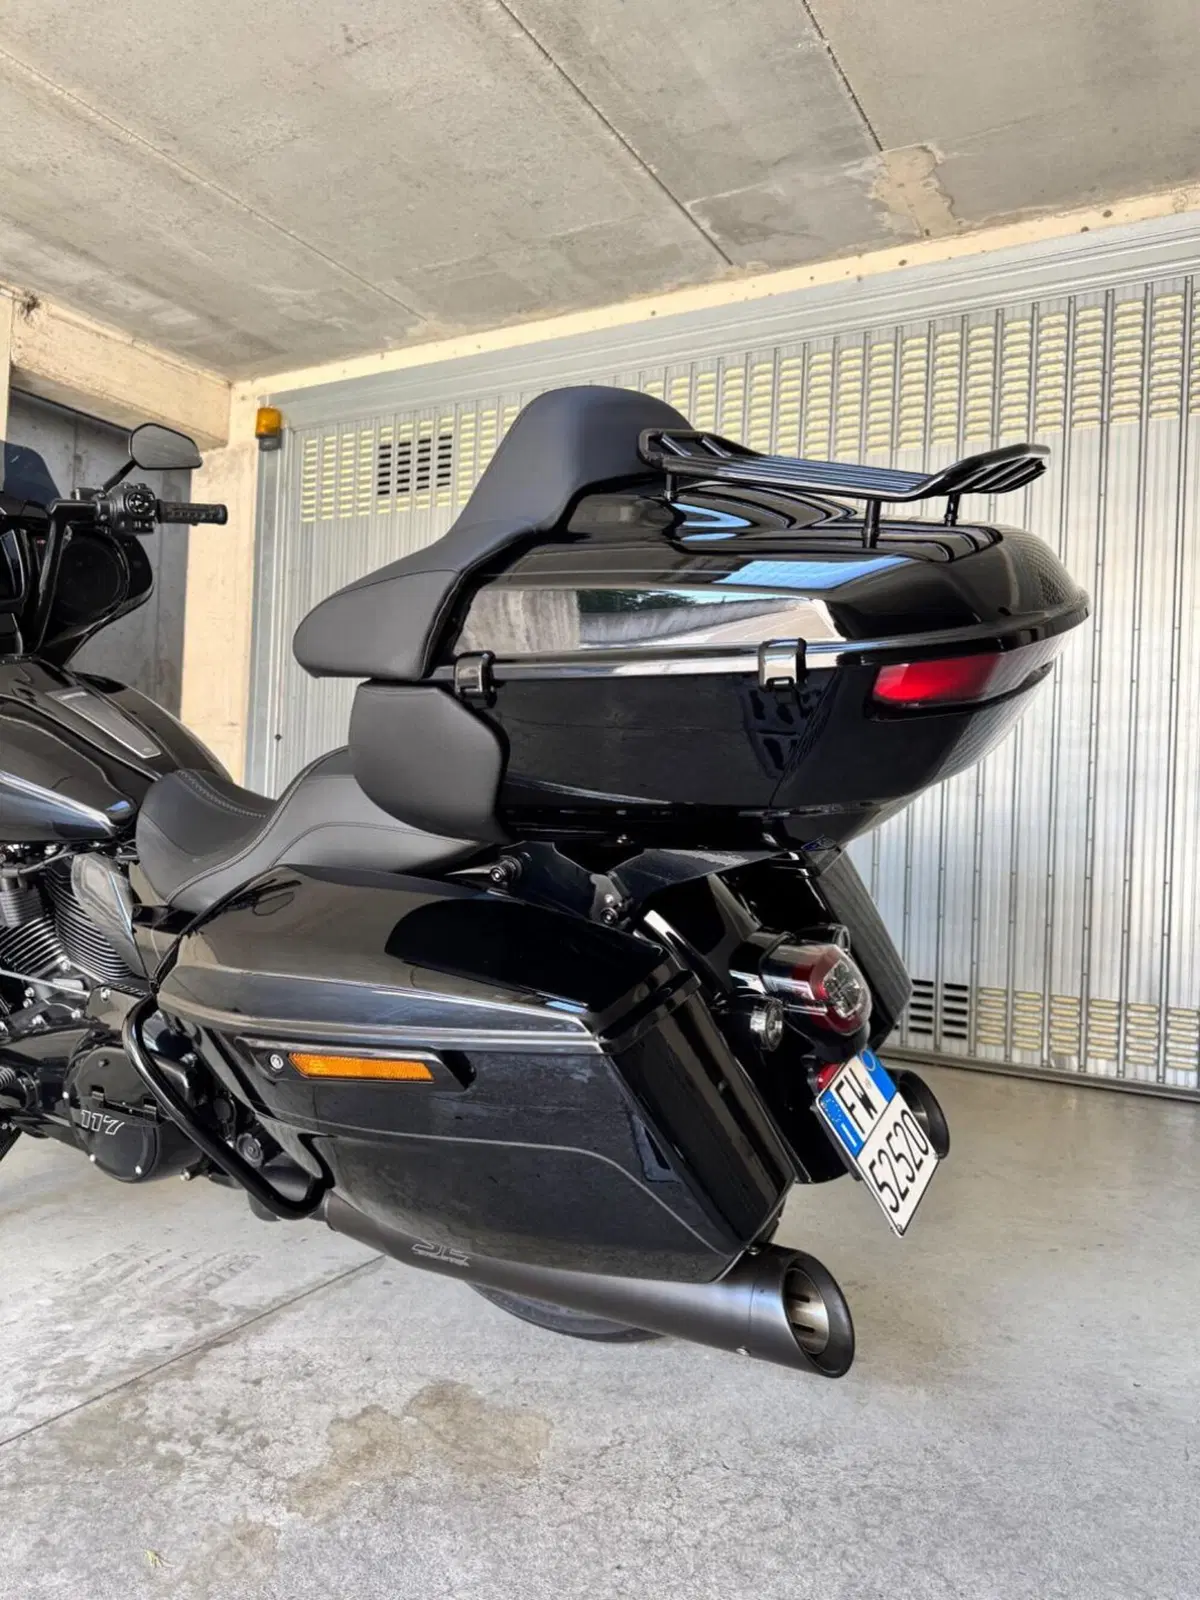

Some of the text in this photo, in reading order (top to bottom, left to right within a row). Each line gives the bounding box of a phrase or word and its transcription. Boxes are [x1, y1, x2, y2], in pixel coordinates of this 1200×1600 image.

[80, 1109, 125, 1136] 117
[835, 1068, 878, 1135] FW
[840, 1122, 858, 1149] I
[868, 1109, 930, 1213] 52520
